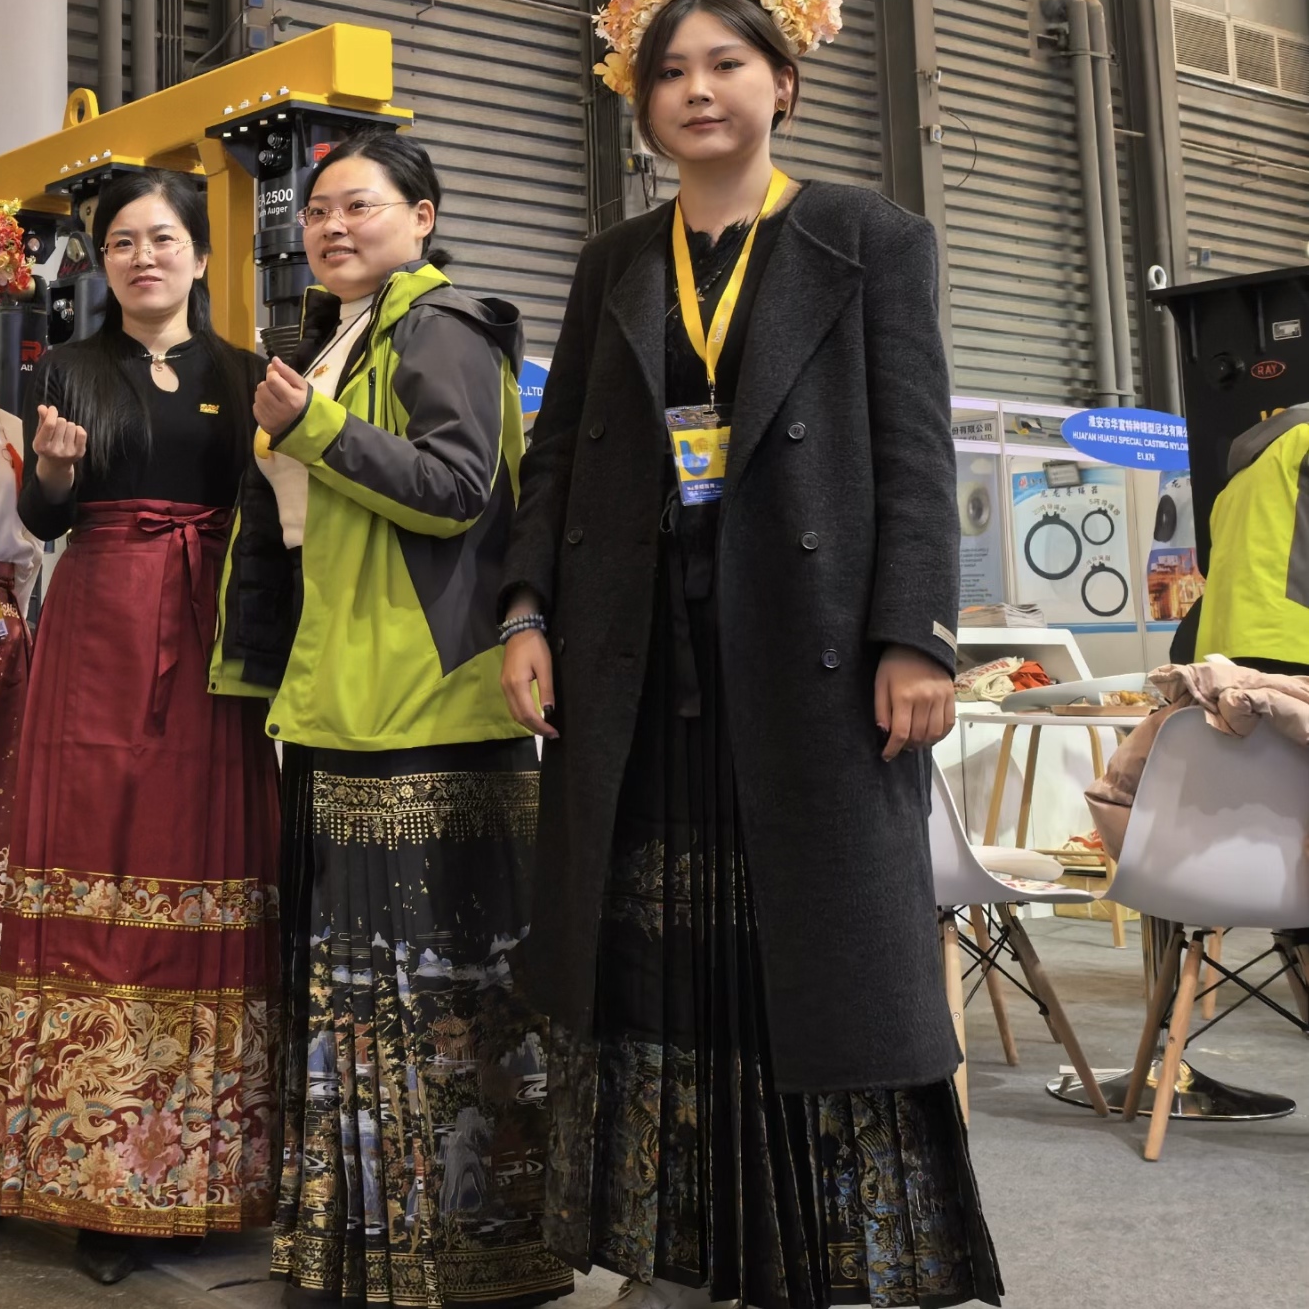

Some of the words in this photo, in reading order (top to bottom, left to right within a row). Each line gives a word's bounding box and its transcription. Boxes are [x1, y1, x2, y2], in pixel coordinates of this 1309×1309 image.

[267, 205, 288, 215] Auger
[1257, 364, 1278, 375] RAY
[1098, 433, 1117, 444] HUAFU
[1118, 436, 1143, 447] SPECIAL
[1144, 438, 1168, 449] CASTING
[1169, 440, 1189, 451] NYLON
